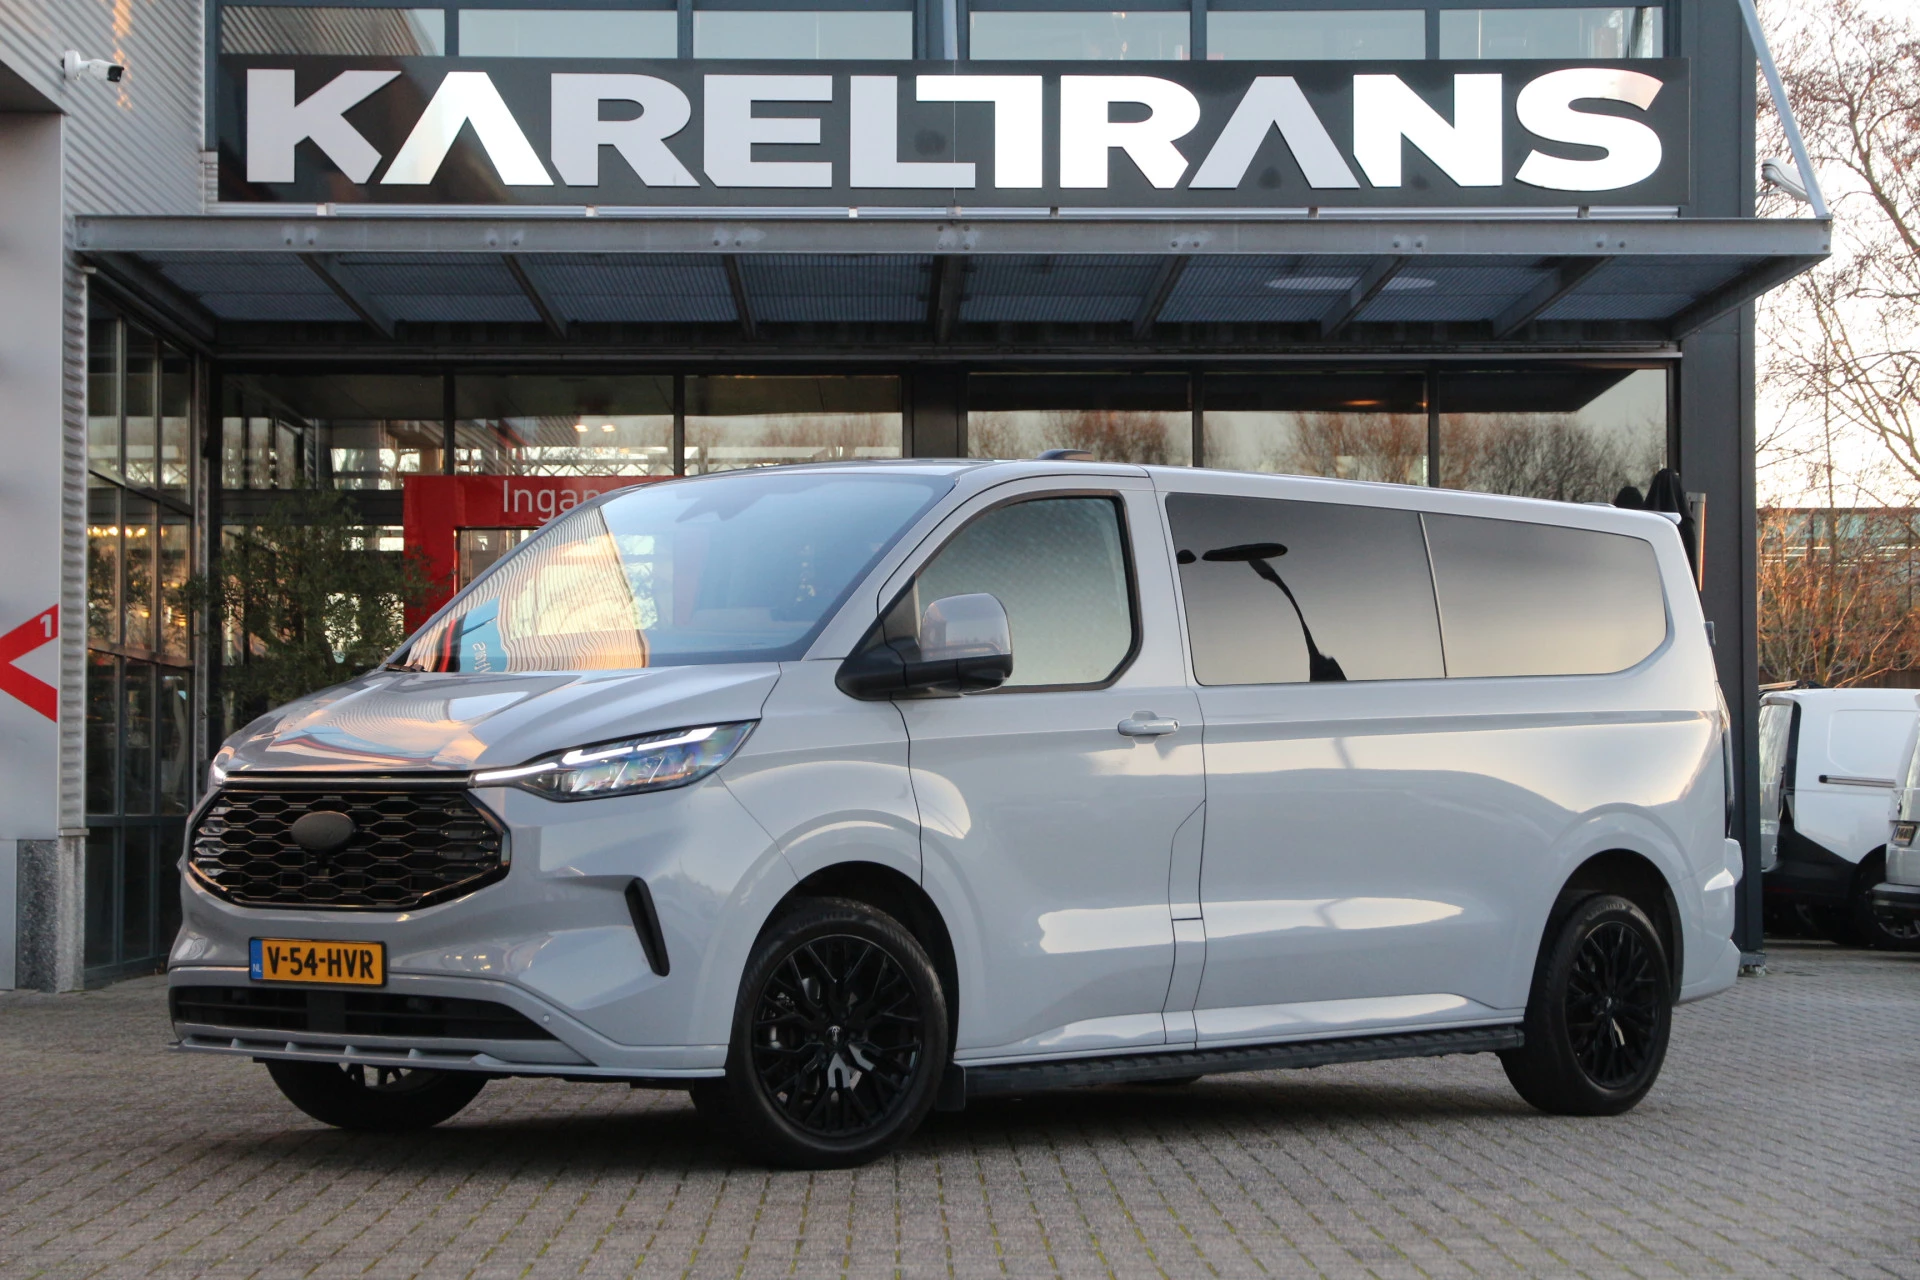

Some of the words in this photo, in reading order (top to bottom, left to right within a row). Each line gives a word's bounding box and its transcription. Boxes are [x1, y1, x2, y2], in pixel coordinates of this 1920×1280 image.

[246, 67, 1663, 191] KARELTRANS
[40, 614, 52, 638] 1
[267, 946, 374, 979] V-54-HVR
